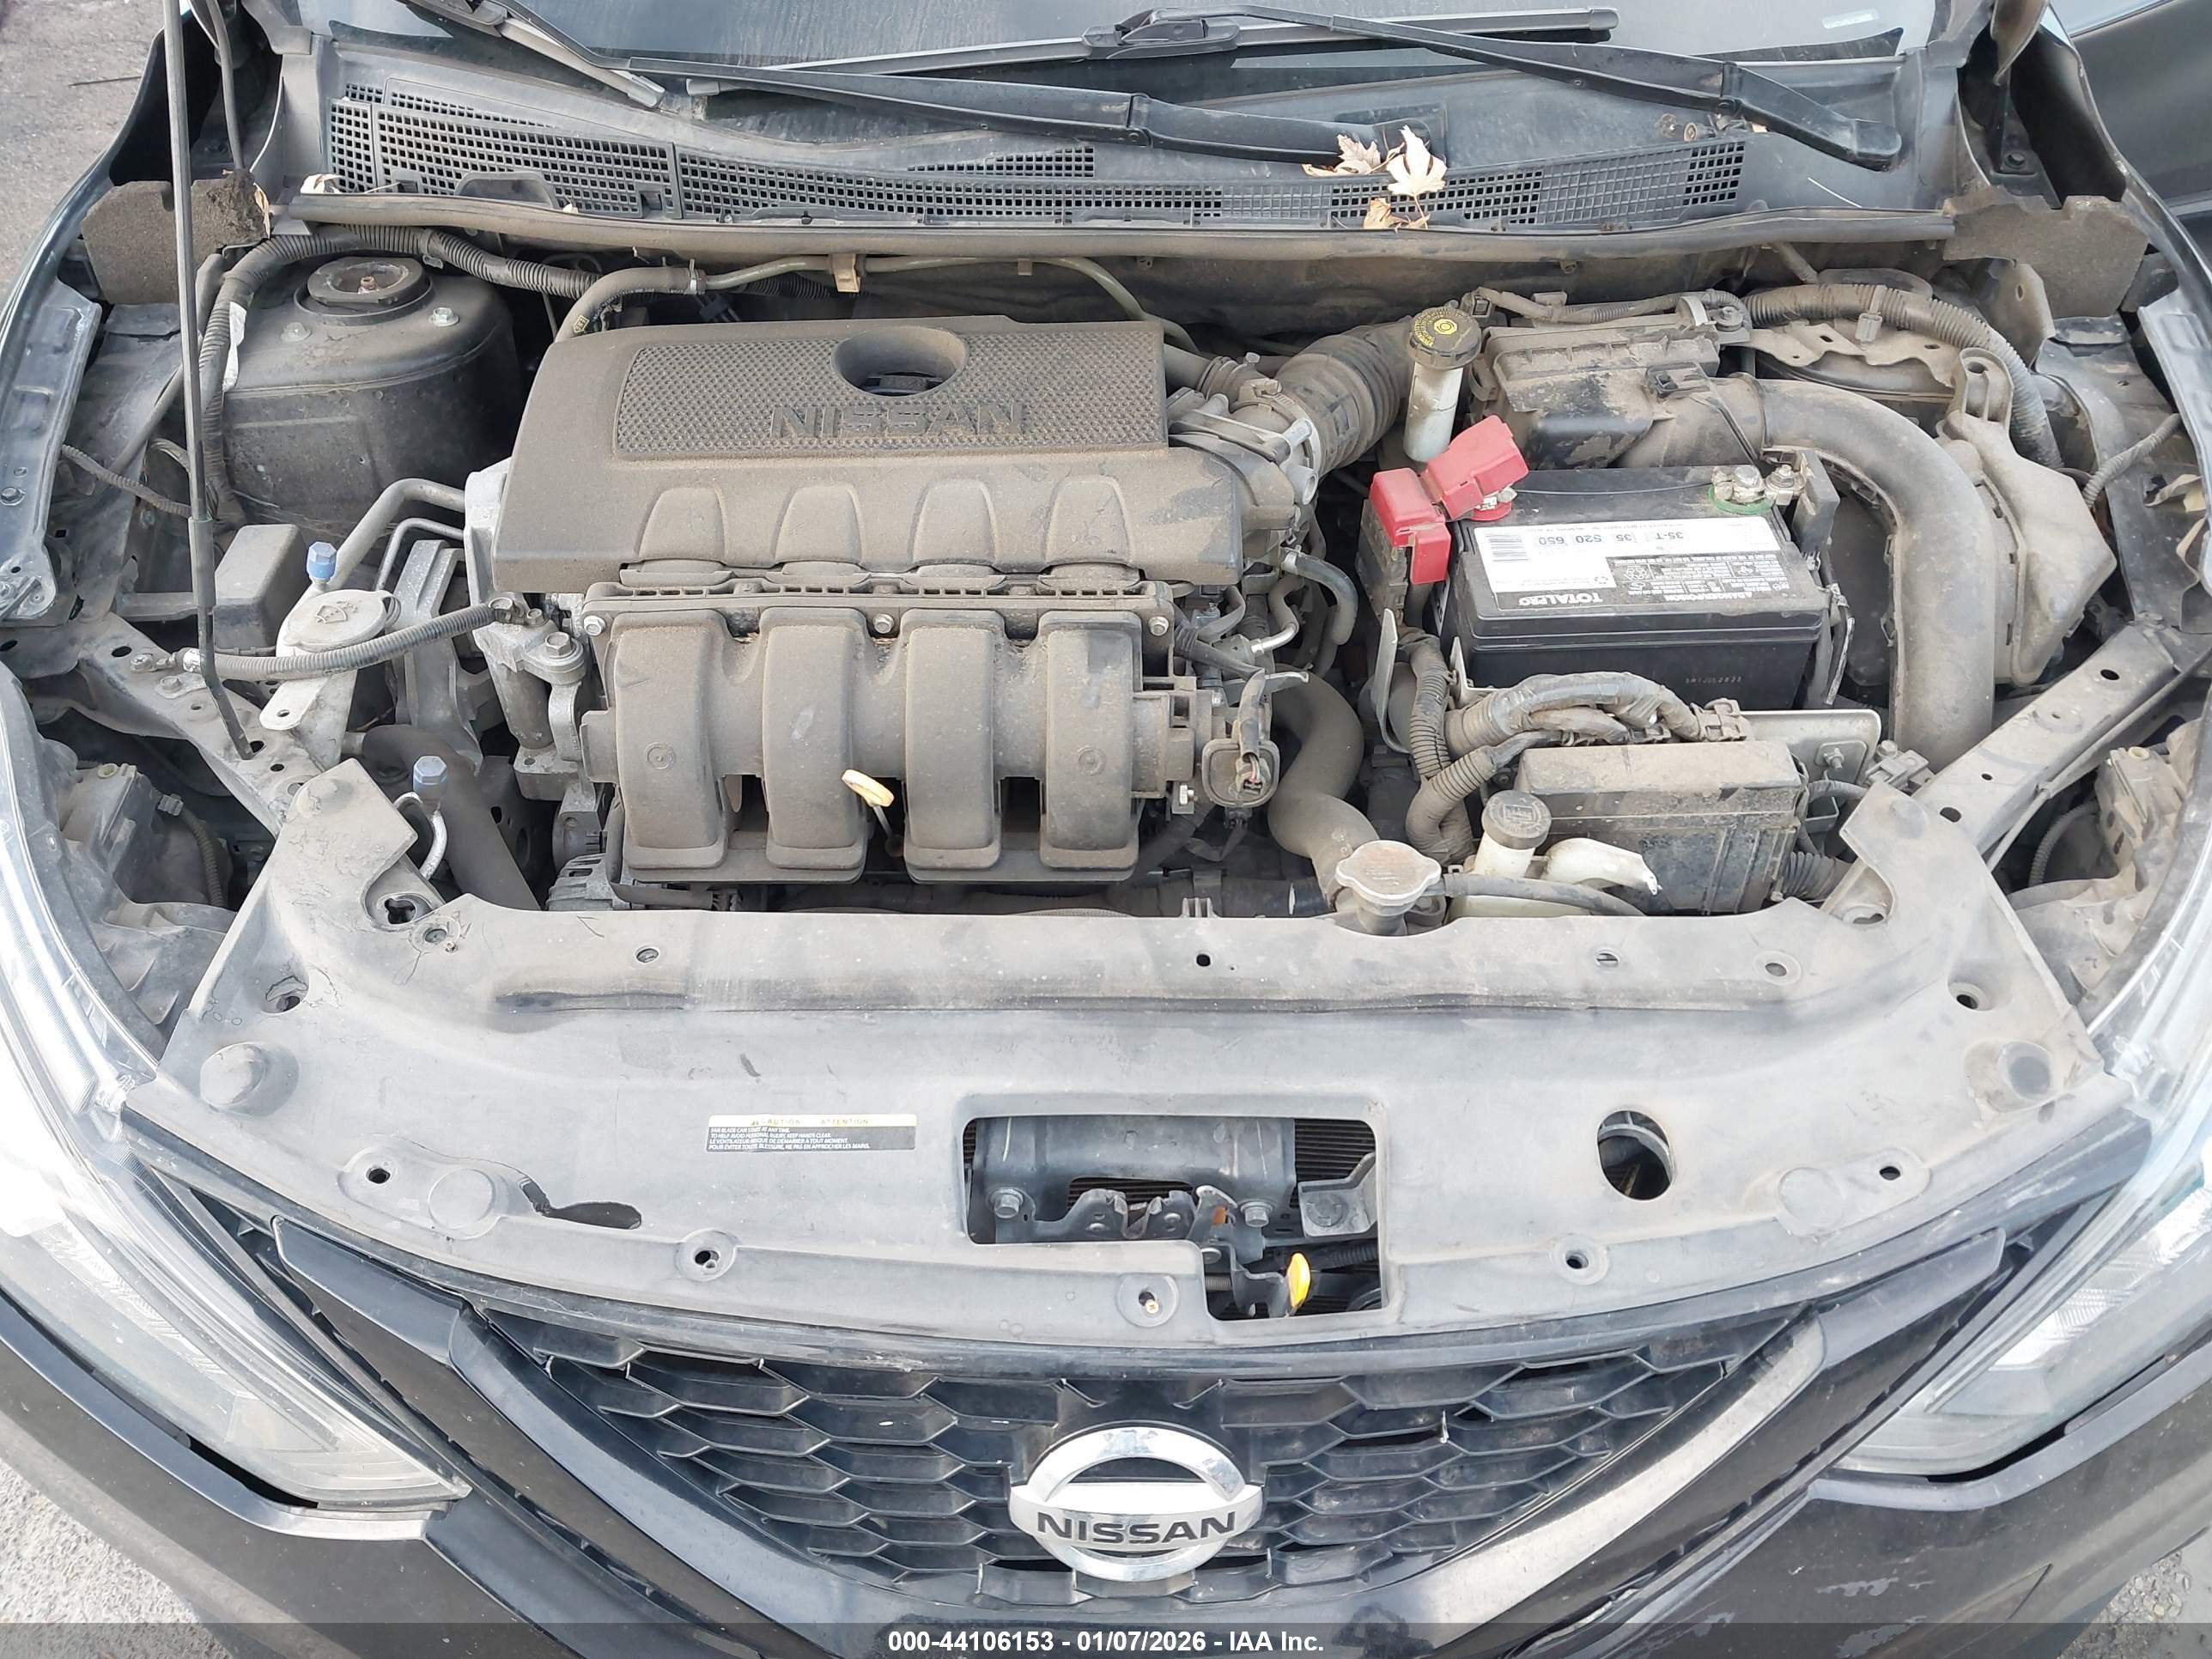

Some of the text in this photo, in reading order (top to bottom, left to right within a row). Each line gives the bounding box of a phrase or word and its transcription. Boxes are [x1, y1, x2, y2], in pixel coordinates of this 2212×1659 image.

[770, 405, 1024, 438] NISSAN
[1539, 537, 1565, 546] 650
[1576, 535, 1602, 544] 520
[1656, 532, 1683, 540] 35-T
[1518, 592, 1603, 606] TOTALPRO
[1037, 1511, 1235, 1544] NISSAN
